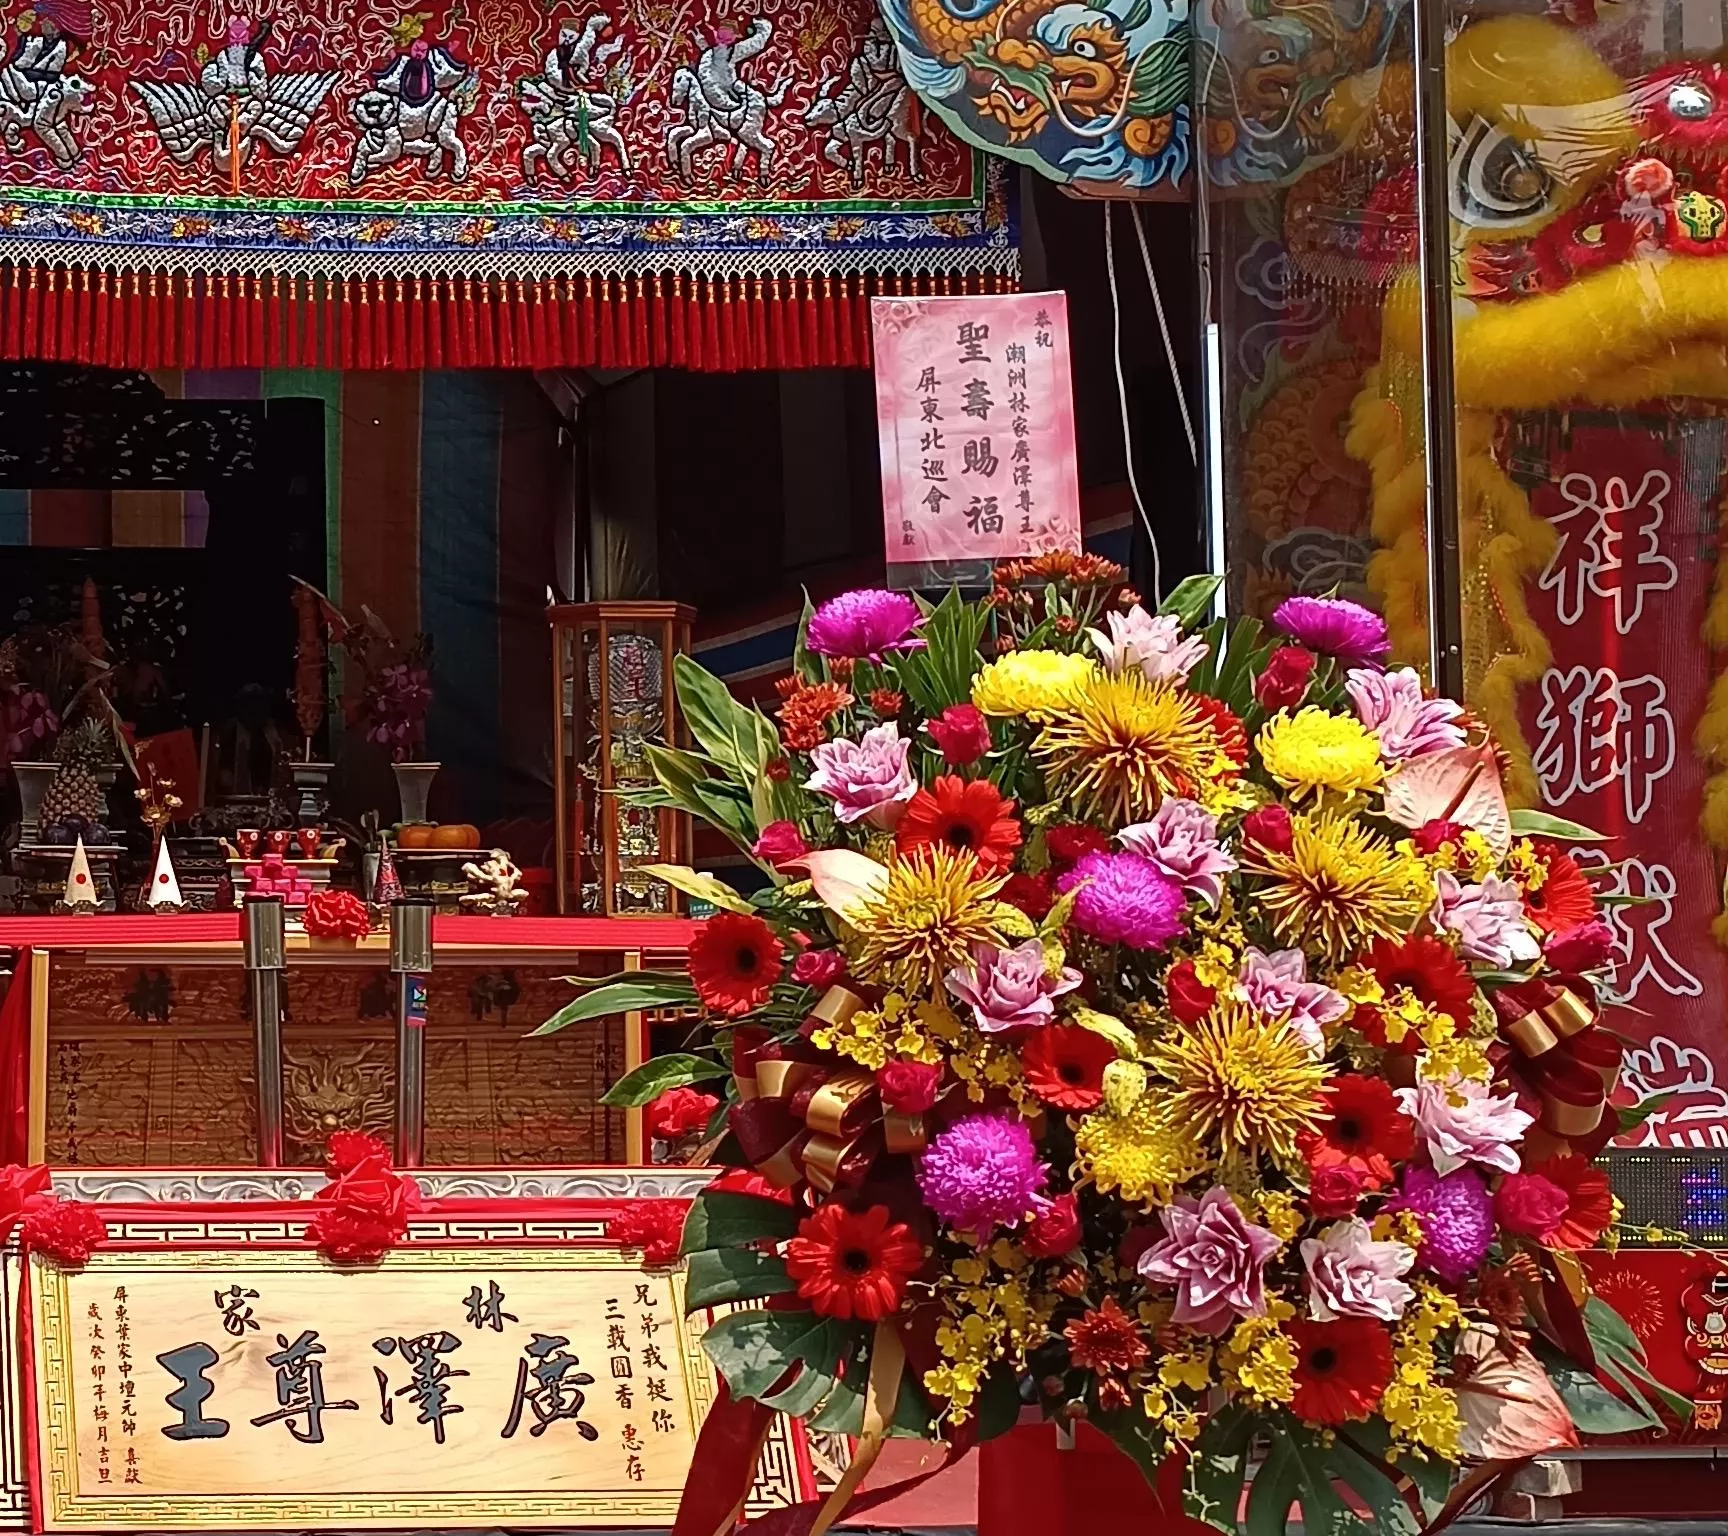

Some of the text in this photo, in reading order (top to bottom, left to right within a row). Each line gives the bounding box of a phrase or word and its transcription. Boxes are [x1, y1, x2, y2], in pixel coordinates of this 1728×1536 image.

[1033, 308, 1054, 348] 恭祝
[915, 366, 951, 514] 屏東北巡會
[956, 321, 1004, 535] 聖壽賜福
[154, 1330, 599, 1445] 廣澤尊王
